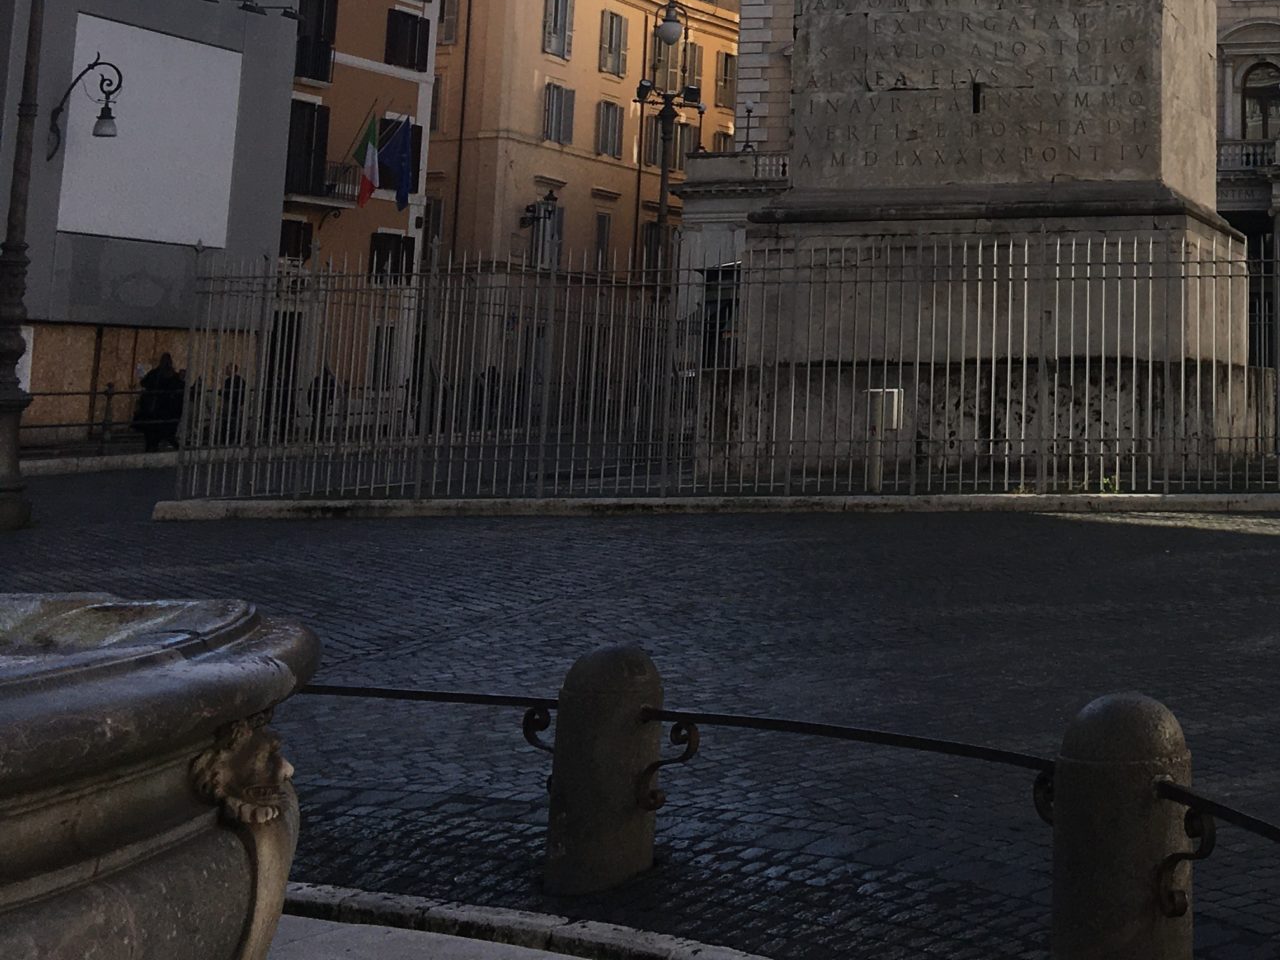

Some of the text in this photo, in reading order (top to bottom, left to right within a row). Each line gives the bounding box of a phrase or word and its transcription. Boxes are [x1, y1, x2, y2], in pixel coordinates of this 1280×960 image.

[872, 12, 1088, 34] EXPVRGATAM
[852, 43, 946, 61] PAVLO
[971, 38, 1136, 57] APOSTOLO
[1026, 64, 1147, 82] STATVA
[808, 96, 961, 115] INAVRATA
[1033, 91, 1144, 108] SVMMO
[970, 119, 1087, 138] POSITA
[1024, 146, 1101, 163] PONT
[1121, 144, 1150, 161] IV
